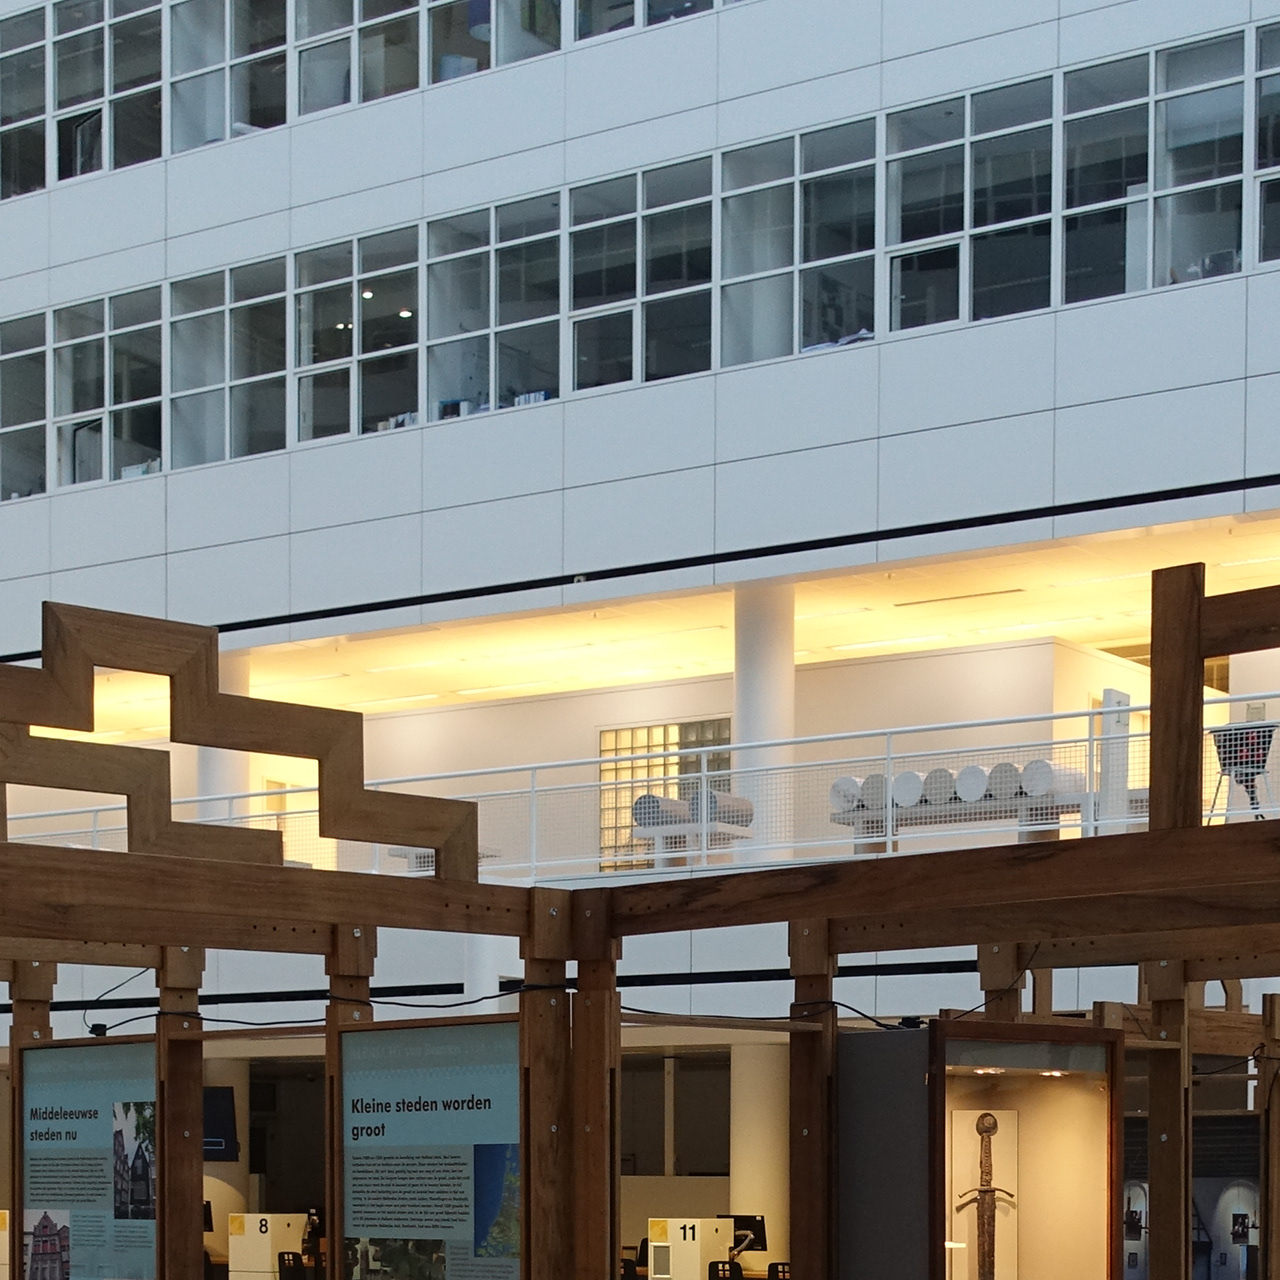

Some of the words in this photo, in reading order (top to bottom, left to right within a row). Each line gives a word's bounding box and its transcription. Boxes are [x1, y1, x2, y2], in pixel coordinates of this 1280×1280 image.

[352, 1098, 391, 1113] Kleine
[396, 1096, 437, 1112] steden
[442, 1094, 491, 1111] worden
[30, 1106, 98, 1120] Middeleeuwse
[30, 1128, 62, 1141] steden
[66, 1131, 77, 1140] nu
[352, 1124, 385, 1140] groot
[259, 1218, 268, 1234] 8
[680, 1224, 696, 1241] 11
